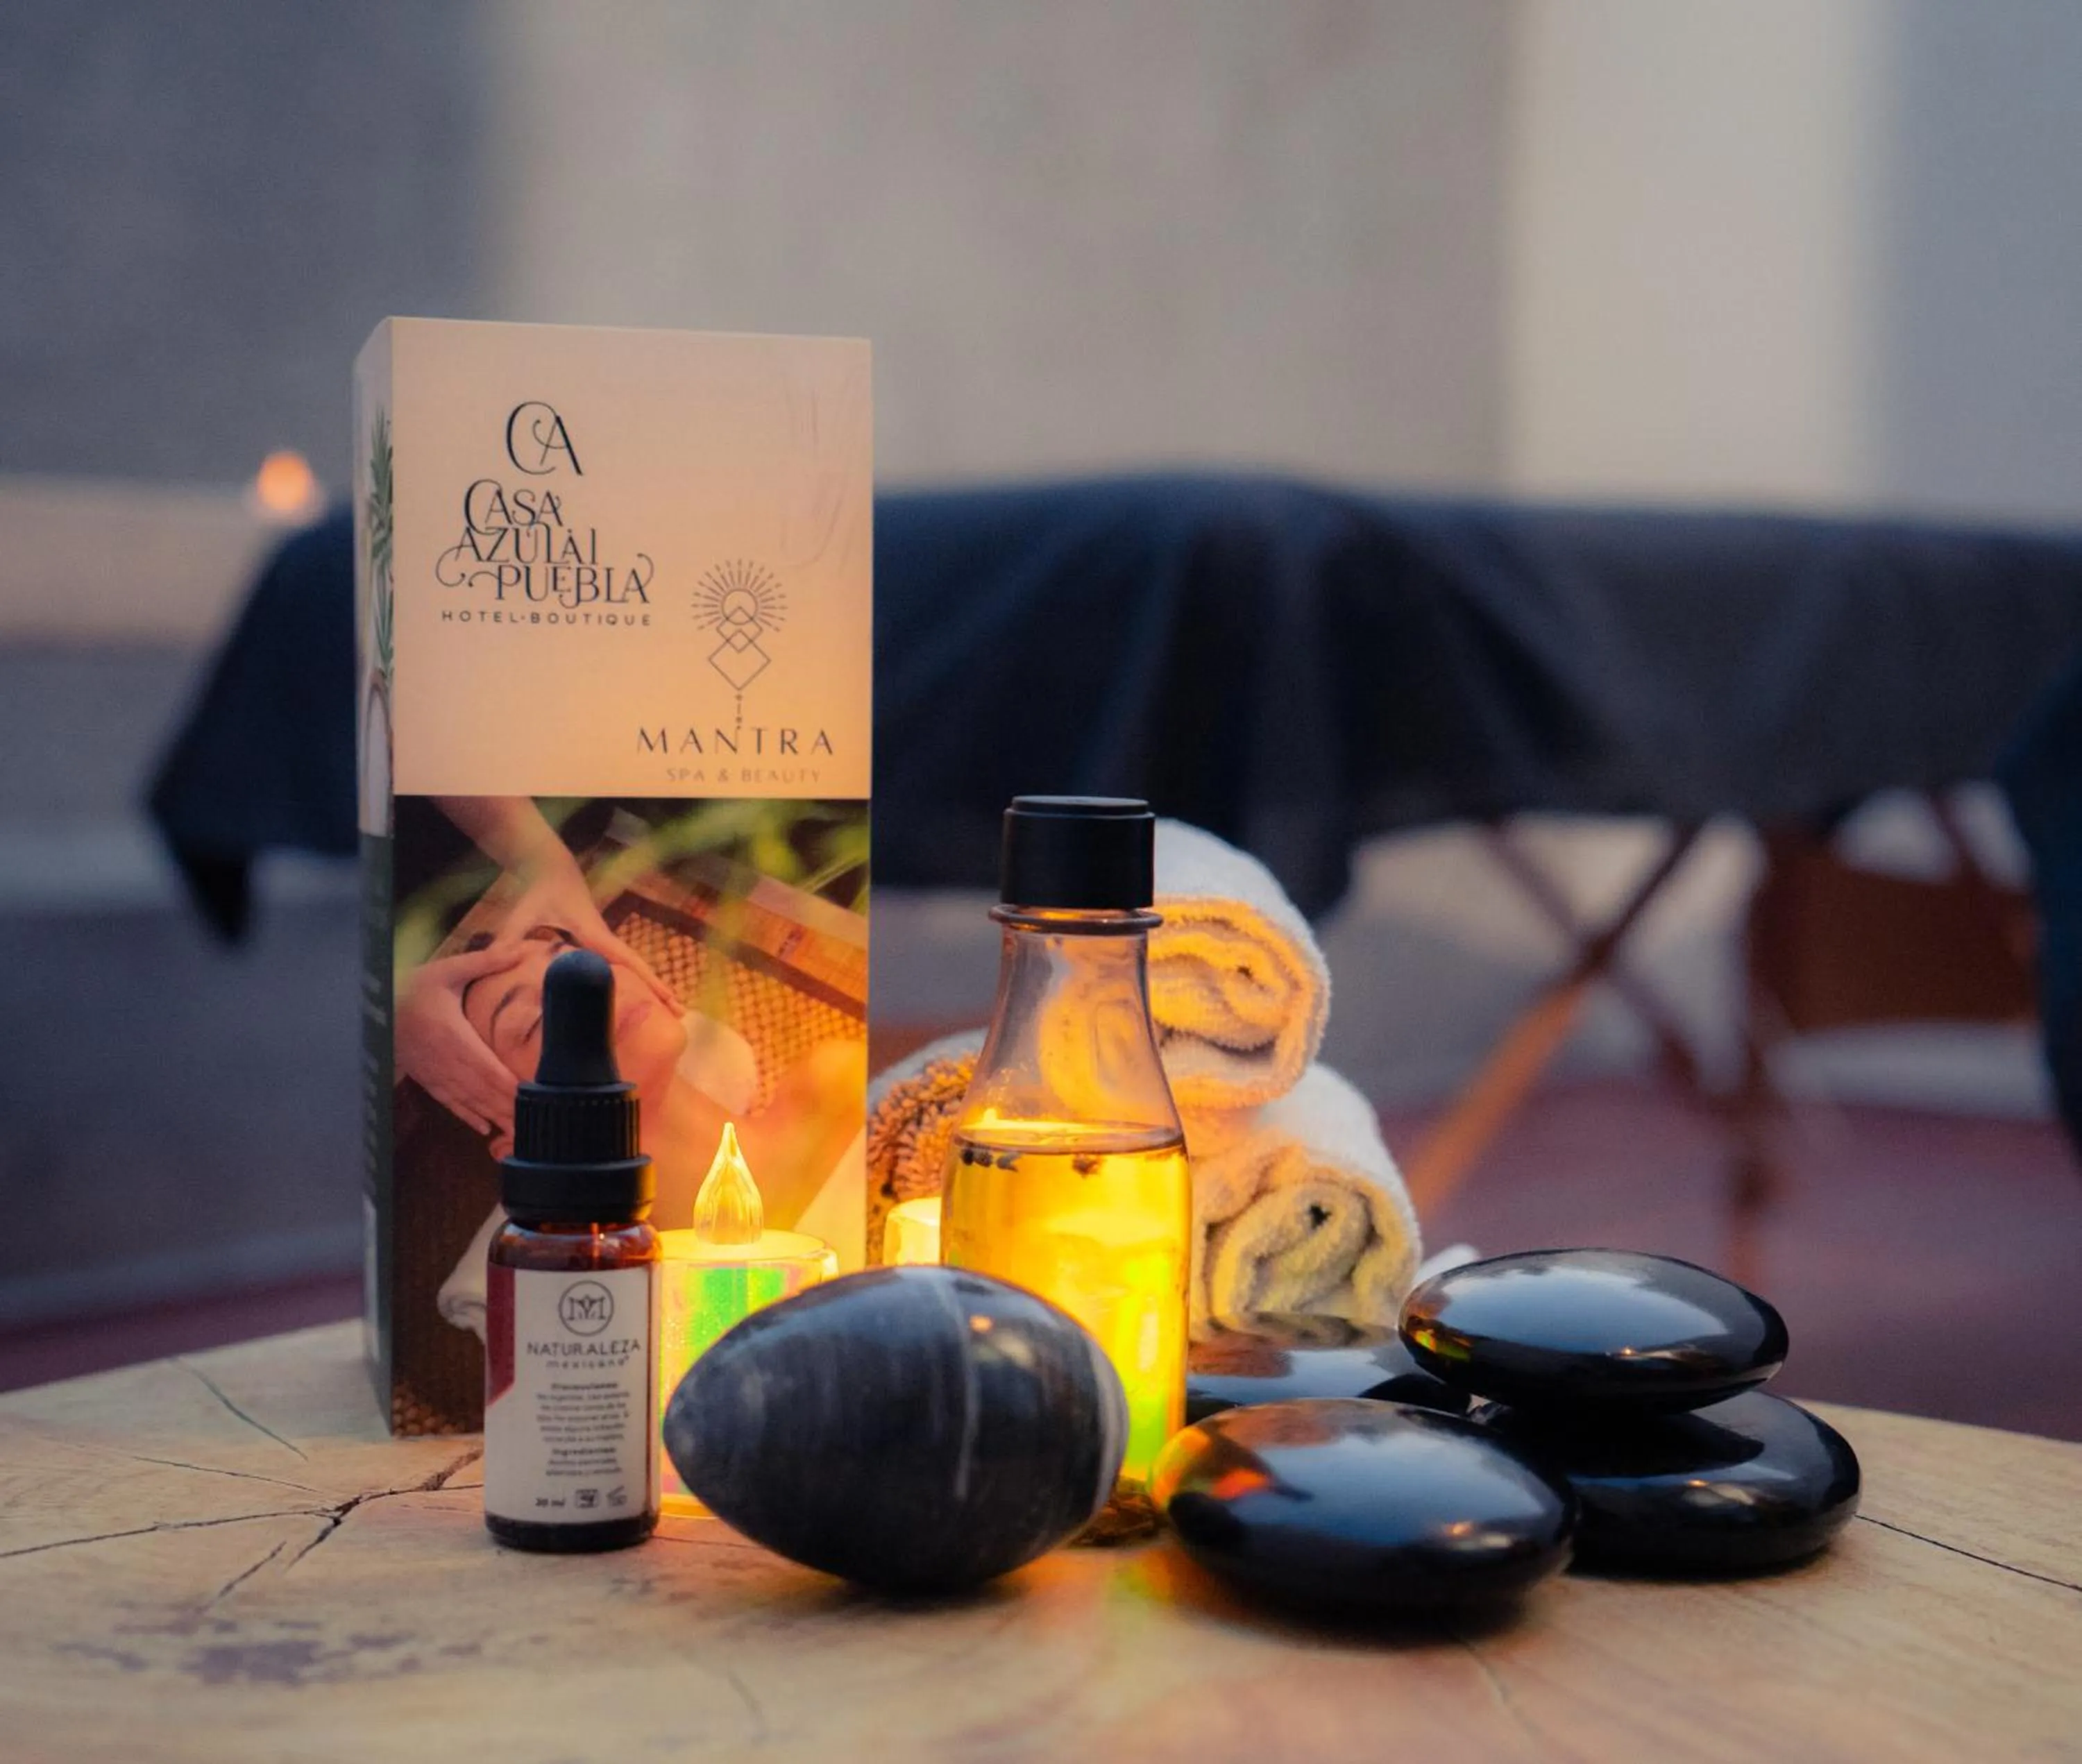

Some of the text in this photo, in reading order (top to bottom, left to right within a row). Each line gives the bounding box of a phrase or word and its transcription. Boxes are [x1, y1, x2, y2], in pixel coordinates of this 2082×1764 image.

[464, 479, 563, 536] CASA
[468, 553, 654, 609] PUEBLA
[637, 727, 833, 755] MANTRA
[666, 767, 821, 783] SPA & BEAUTY
[527, 1339, 641, 1356] NATURALEZA
